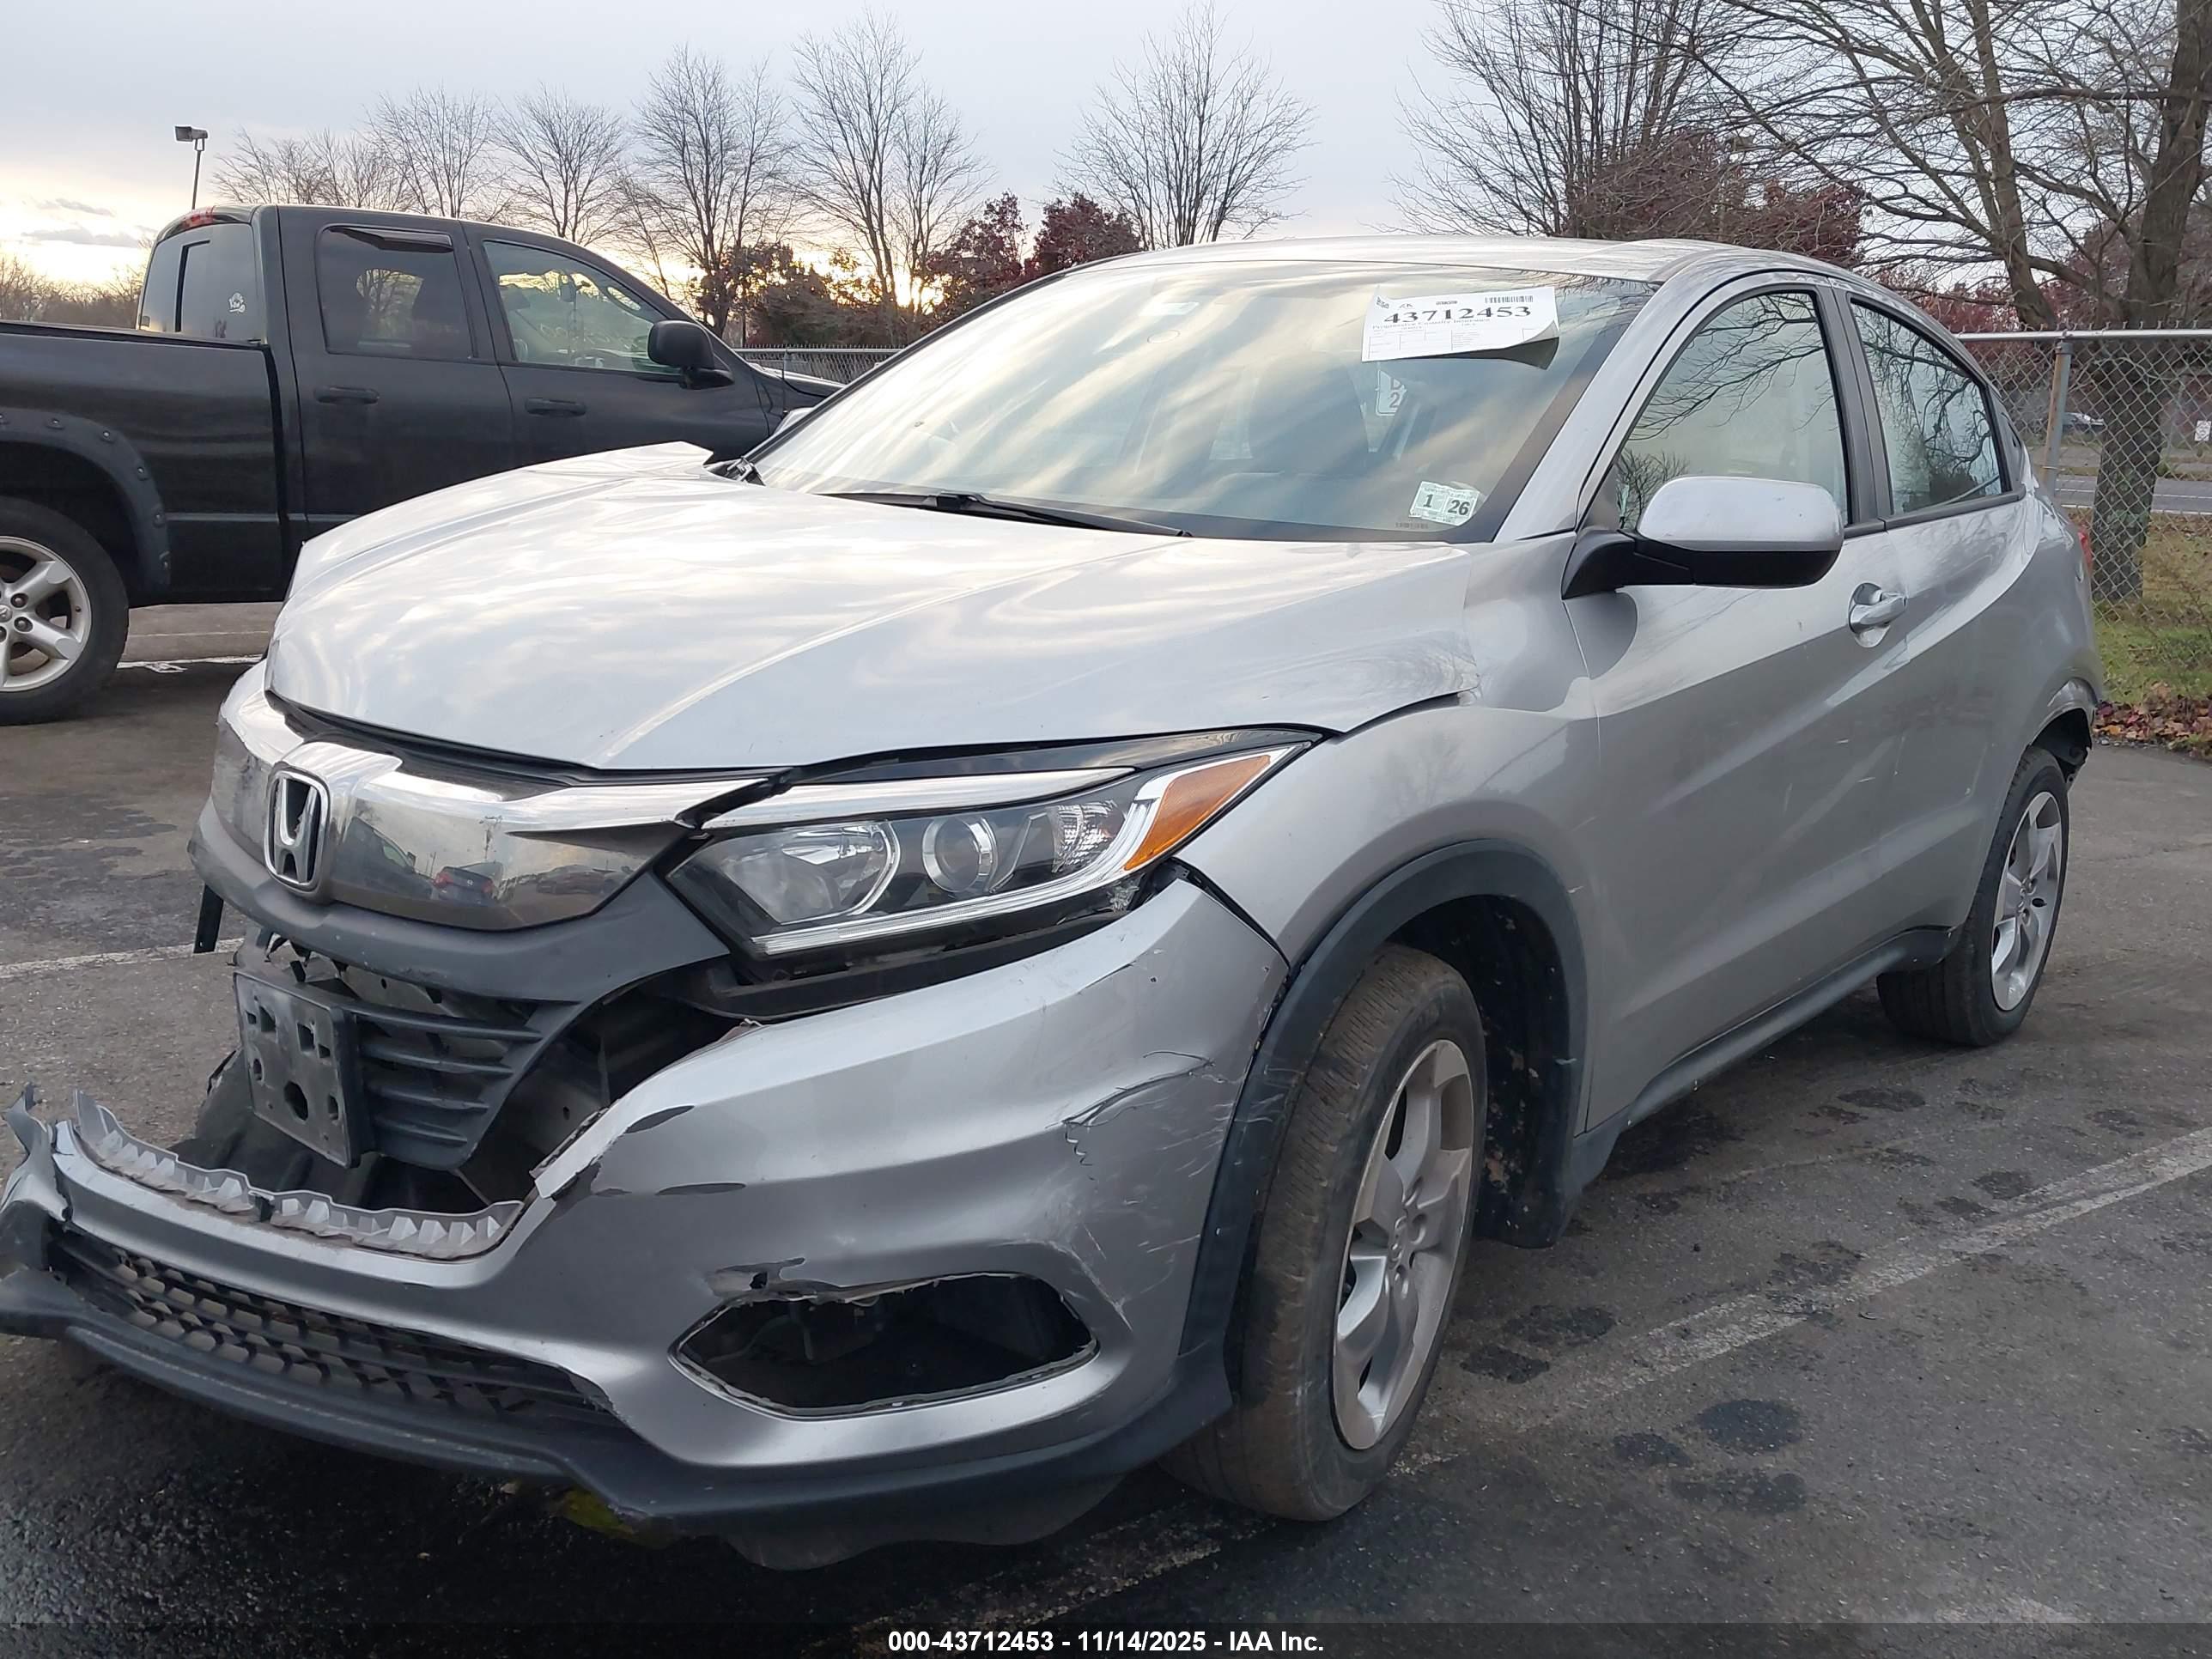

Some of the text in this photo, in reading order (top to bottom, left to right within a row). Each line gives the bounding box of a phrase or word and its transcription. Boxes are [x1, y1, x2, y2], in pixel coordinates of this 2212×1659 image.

[1383, 306, 1532, 324] 43712453
[1423, 494, 1434, 508] 1
[1447, 499, 1471, 516] 26
